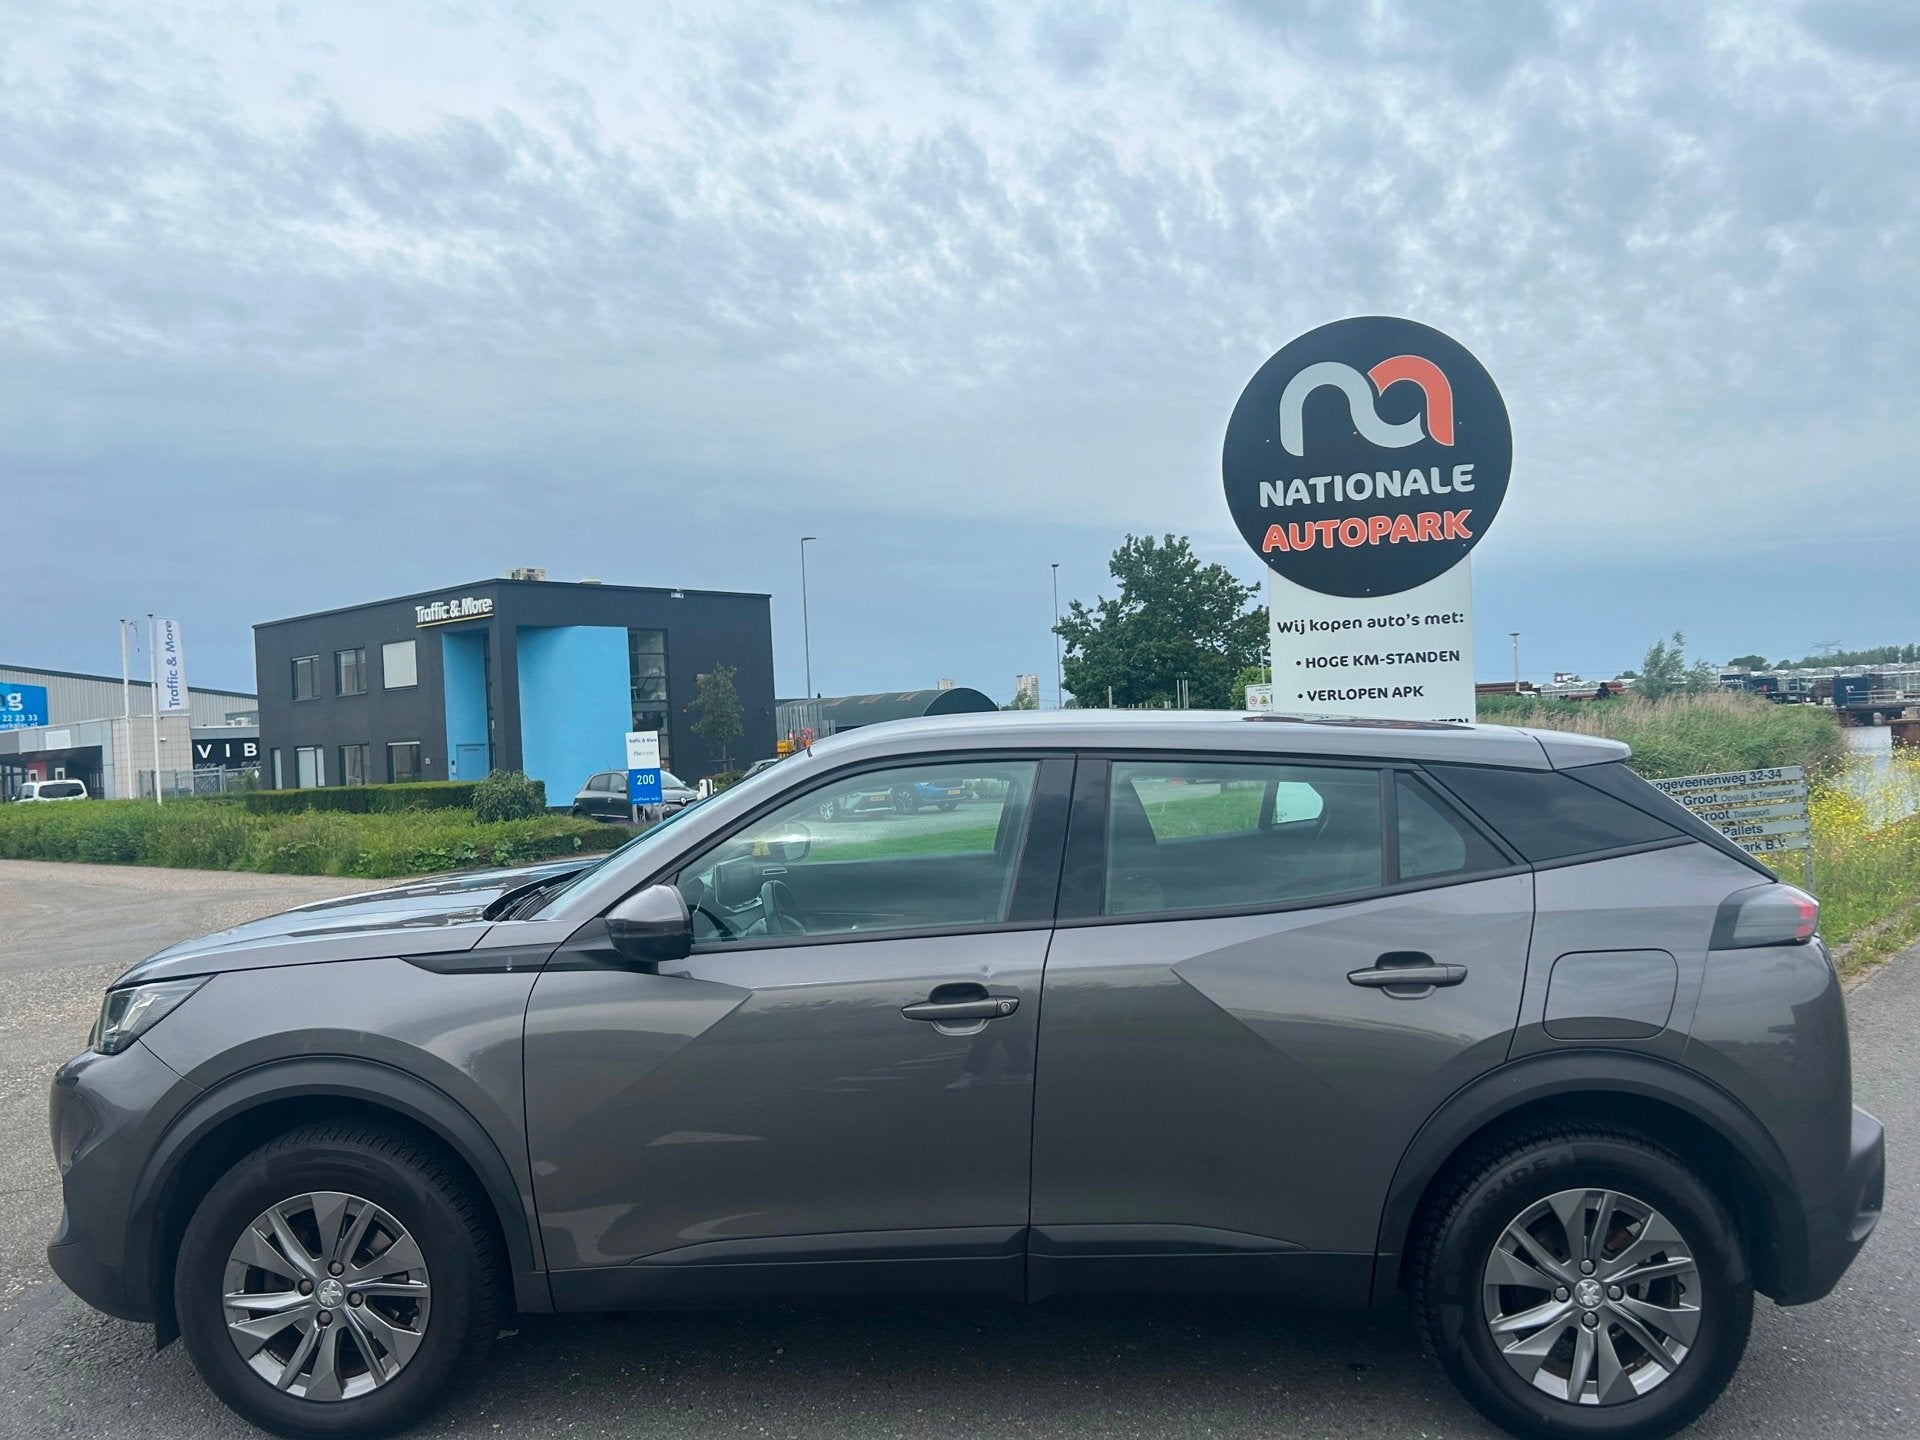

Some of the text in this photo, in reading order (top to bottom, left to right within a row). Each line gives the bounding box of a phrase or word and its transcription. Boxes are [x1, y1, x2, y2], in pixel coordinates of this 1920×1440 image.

[1259, 464, 1475, 507] NATIONALE
[1262, 509, 1473, 552] AUTOPARK
[415, 597, 493, 623] Traffic & More
[1277, 612, 1464, 635] Wij kopen auto's met:
[165, 620, 180, 708] Traffic & More
[1305, 650, 1460, 668] HOGE KM-STANDEN
[1307, 686, 1424, 701] VERLOPEN APK
[636, 774, 655, 785] 200
[1654, 769, 1782, 792] ogeveenenweg 32-34
[1683, 794, 1718, 806] Groot
[1758, 788, 1795, 799] Transport
[1696, 808, 1770, 821] Groot Transport
[1722, 824, 1764, 837] Pallets
[1740, 841, 1763, 852] ark
